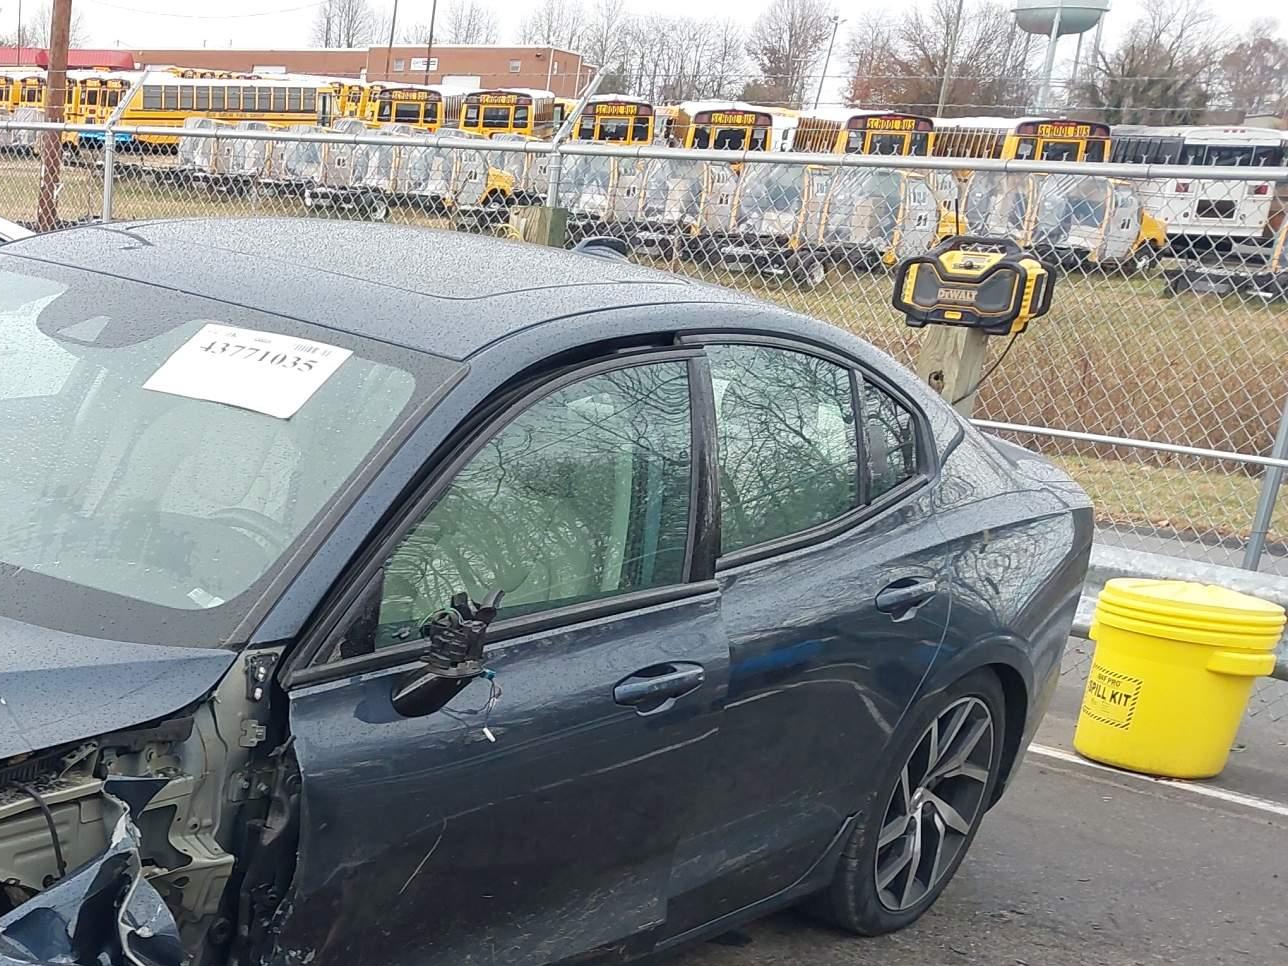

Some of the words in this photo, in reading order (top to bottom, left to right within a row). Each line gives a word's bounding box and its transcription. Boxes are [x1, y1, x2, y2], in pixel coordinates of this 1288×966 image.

[868, 119, 896, 129] SCHOOL
[898, 120, 915, 129] BUS
[1039, 125, 1069, 136] SCHOOL
[1072, 126, 1090, 136] BUS
[199, 340, 319, 372] 43771035
[1088, 680, 1107, 700] SPILL
[1109, 690, 1132, 707] KIT
